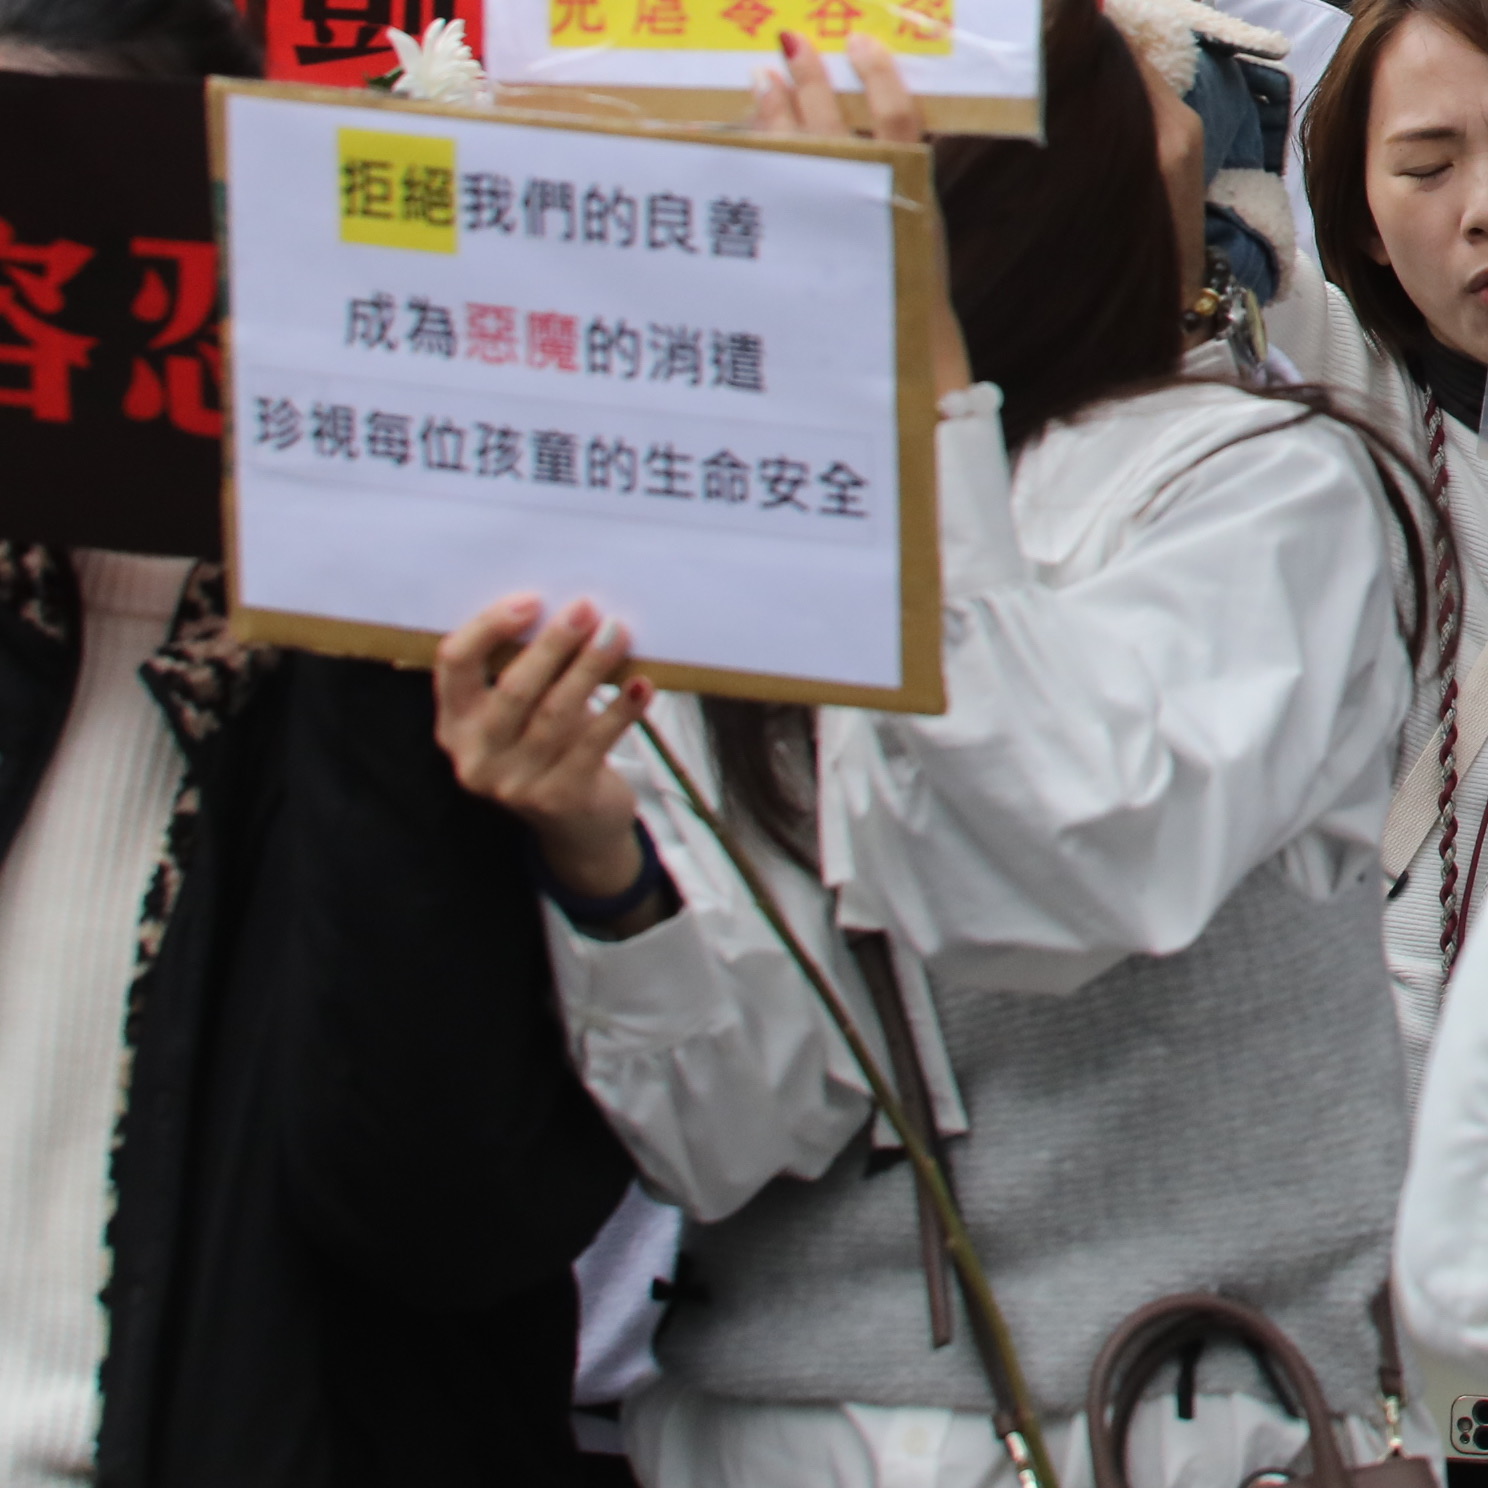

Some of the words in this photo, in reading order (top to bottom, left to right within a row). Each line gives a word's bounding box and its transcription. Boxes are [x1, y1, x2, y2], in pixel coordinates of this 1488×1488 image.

[341, 158, 765, 261] 拒絕我們的良善
[345, 292, 767, 394] 成為惡魔的消遣
[254, 395, 870, 520] 珍視每位孩童的生命安全
